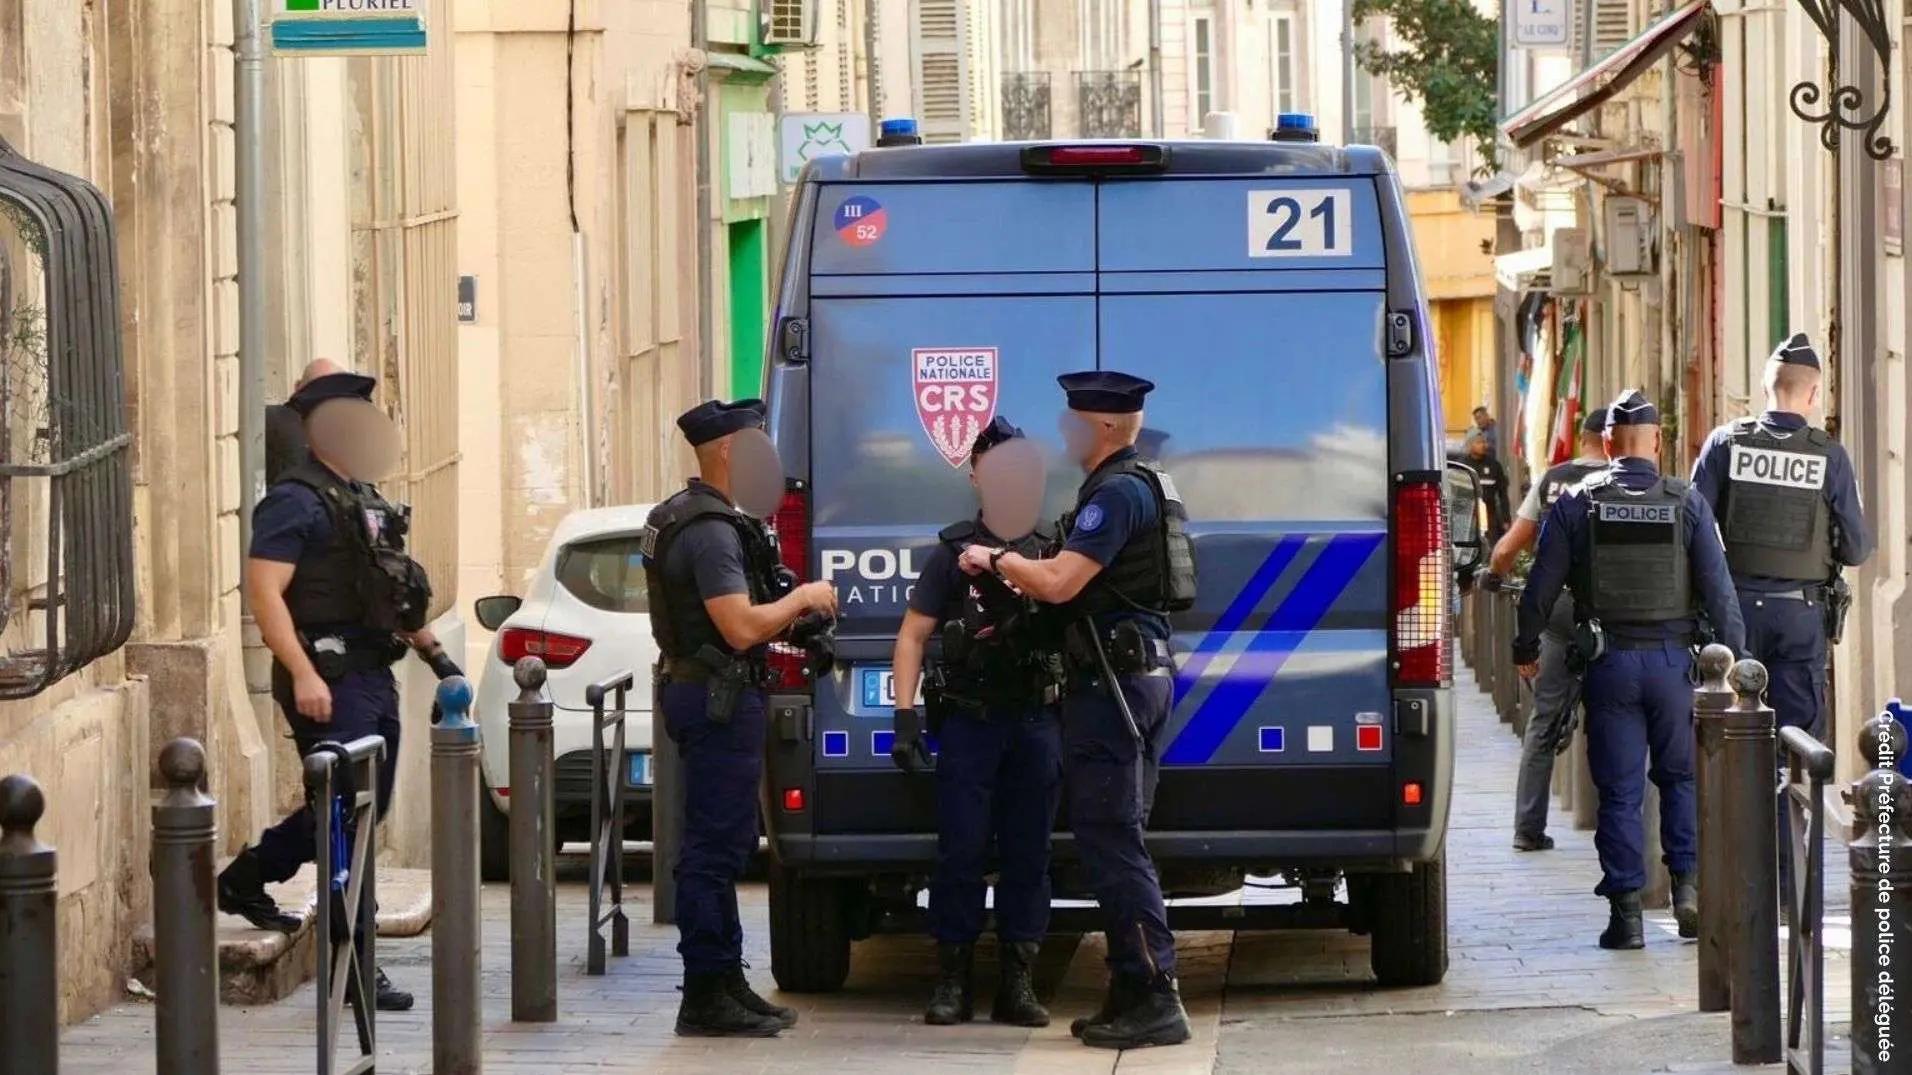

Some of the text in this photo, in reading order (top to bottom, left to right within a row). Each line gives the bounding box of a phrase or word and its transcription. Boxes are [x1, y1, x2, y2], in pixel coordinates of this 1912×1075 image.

[323, 0, 412, 10] PLURIEL
[844, 205, 861, 217] III
[1266, 195, 1335, 250] 21
[857, 225, 877, 240] 52
[926, 355, 985, 367] POLICE
[920, 368, 991, 379] NATIONALE
[920, 384, 989, 412] CRS
[1736, 452, 1820, 485] POLICE
[1605, 506, 1670, 520] POLICE
